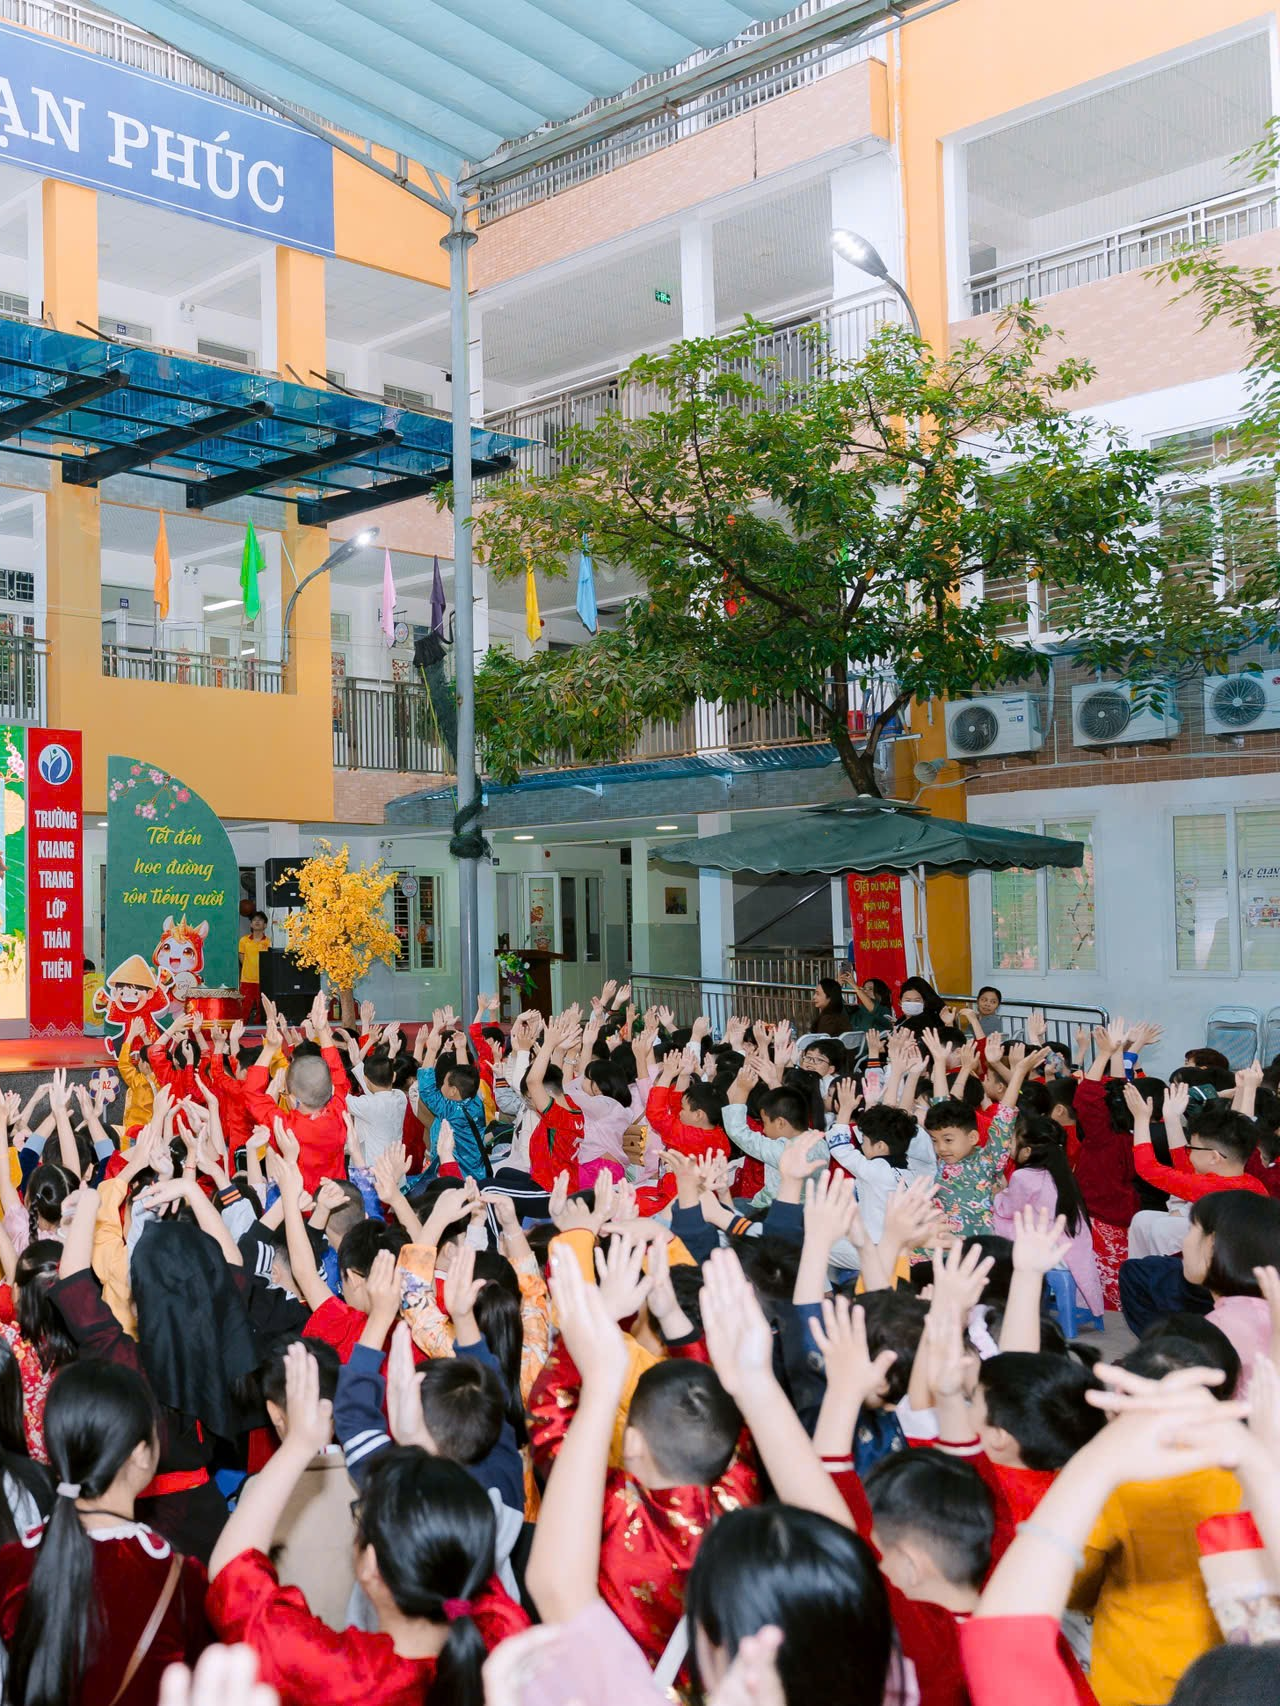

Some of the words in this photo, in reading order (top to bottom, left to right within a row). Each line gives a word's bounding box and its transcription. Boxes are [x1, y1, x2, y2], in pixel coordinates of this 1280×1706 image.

[106, 110, 285, 214] PHÚC
[34, 806, 78, 830] TRƯỜNG
[146, 825, 175, 845] Tết
[173, 826, 202, 846] đến
[37, 840, 75, 860] KHANG
[38, 870, 74, 890] TRANG
[133, 857, 162, 877] học
[165, 858, 214, 882] đường
[46, 897, 67, 919] LỚP
[123, 887, 148, 907] rộn
[149, 885, 190, 911] tiếng
[192, 889, 225, 906] cười
[42, 928, 71, 949] THÂN
[41, 957, 72, 982] THIỆN
